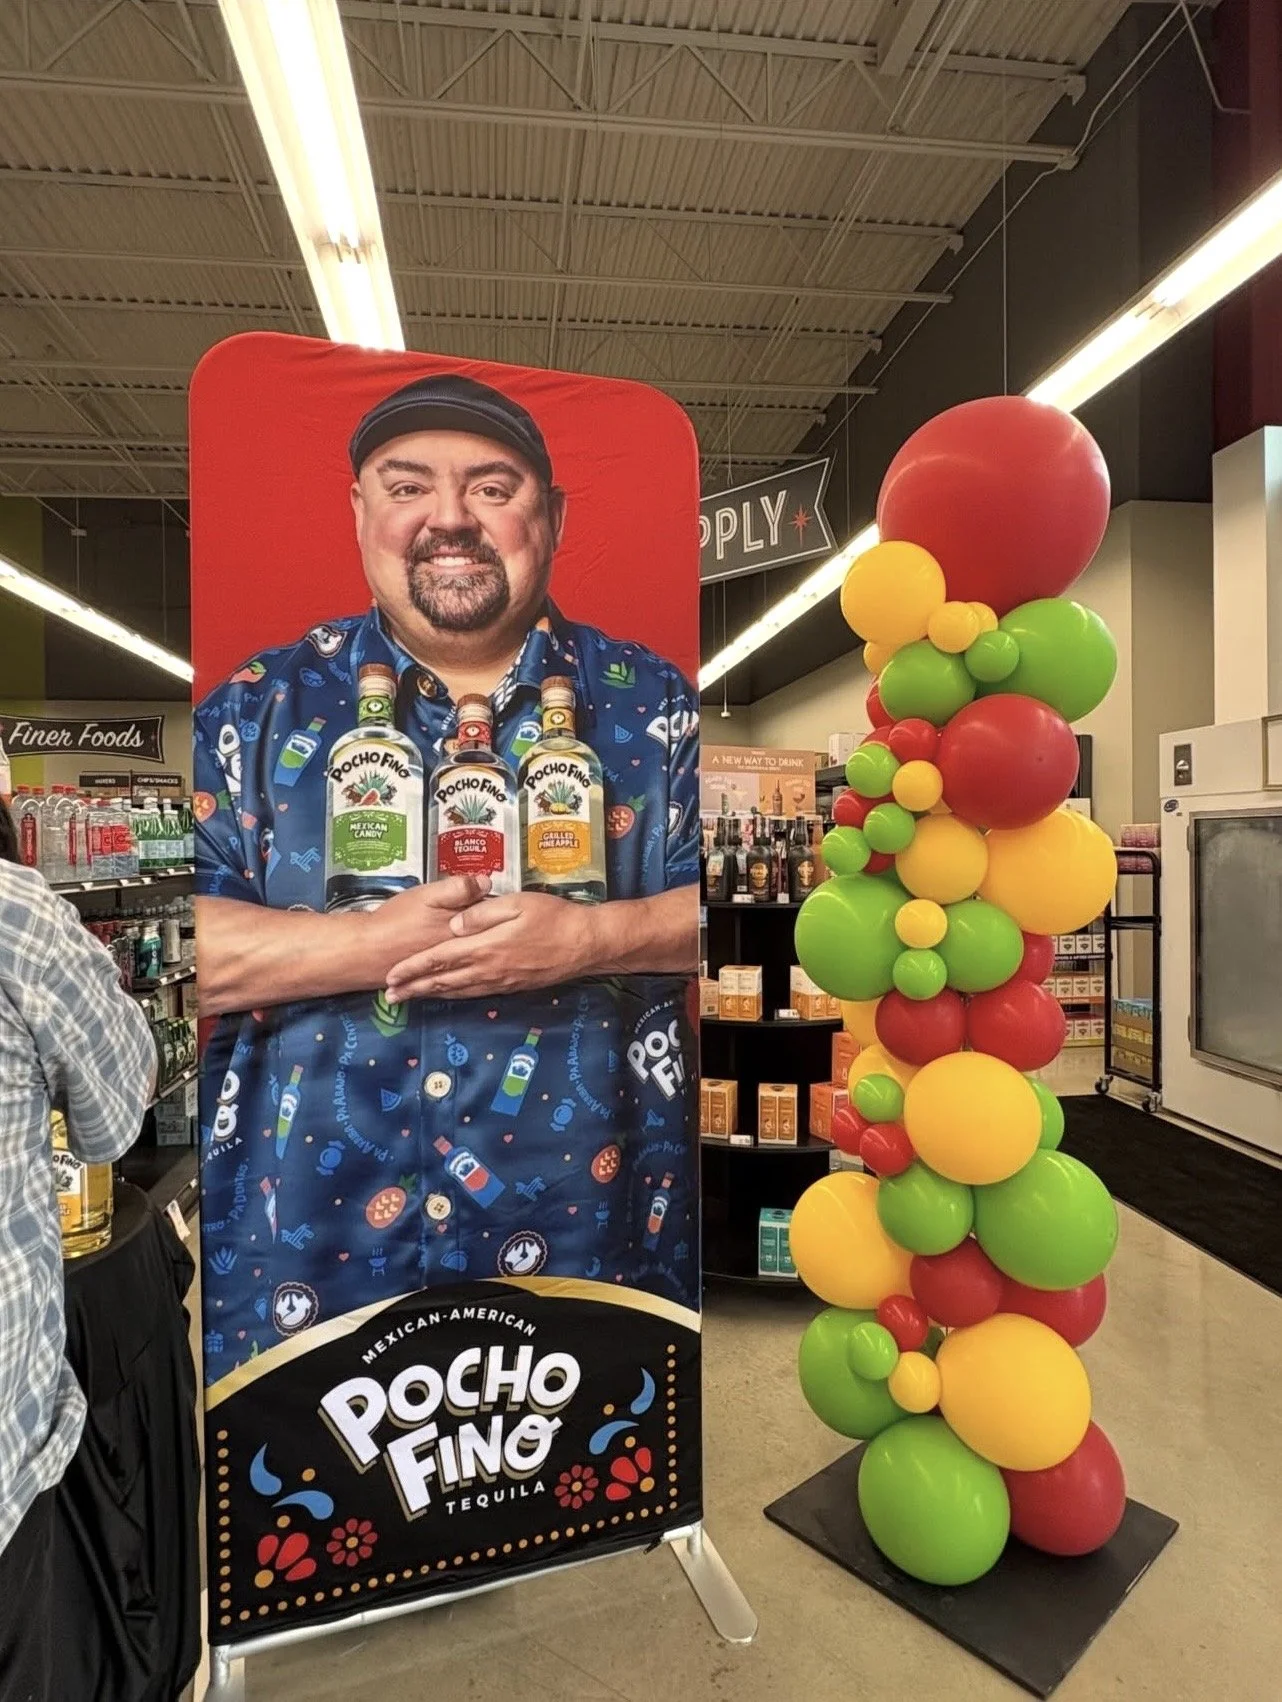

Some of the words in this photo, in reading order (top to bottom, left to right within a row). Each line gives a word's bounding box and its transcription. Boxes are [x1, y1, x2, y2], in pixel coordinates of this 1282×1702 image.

[8, 721, 73, 747] Finer
[78, 723, 144, 748] Foods
[330, 751, 381, 782] POCHO
[380, 752, 411, 779] FINO
[712, 755, 720, 764] A
[722, 756, 741, 765] NEW
[743, 756, 762, 765] WAY
[765, 757, 777, 766] TO
[778, 758, 804, 767] DRINK
[525, 762, 568, 789] POCHO
[568, 763, 591, 788] FINO
[436, 778, 480, 803] POCHO
[480, 778, 508, 802] FINO
[349, 822, 388, 831] MEXICAN
[354, 830, 383, 839] CANDY
[543, 832, 574, 840] GRILLED
[454, 845, 487, 853] TEQUILA
[538, 840, 579, 848] PINEAPPLE
[361, 1306, 538, 1365] MEXICAN-AMERICAN
[317, 1345, 581, 1474] POCHO
[384, 1413, 563, 1522] FINO
[445, 1480, 546, 1516] TEQUILA
